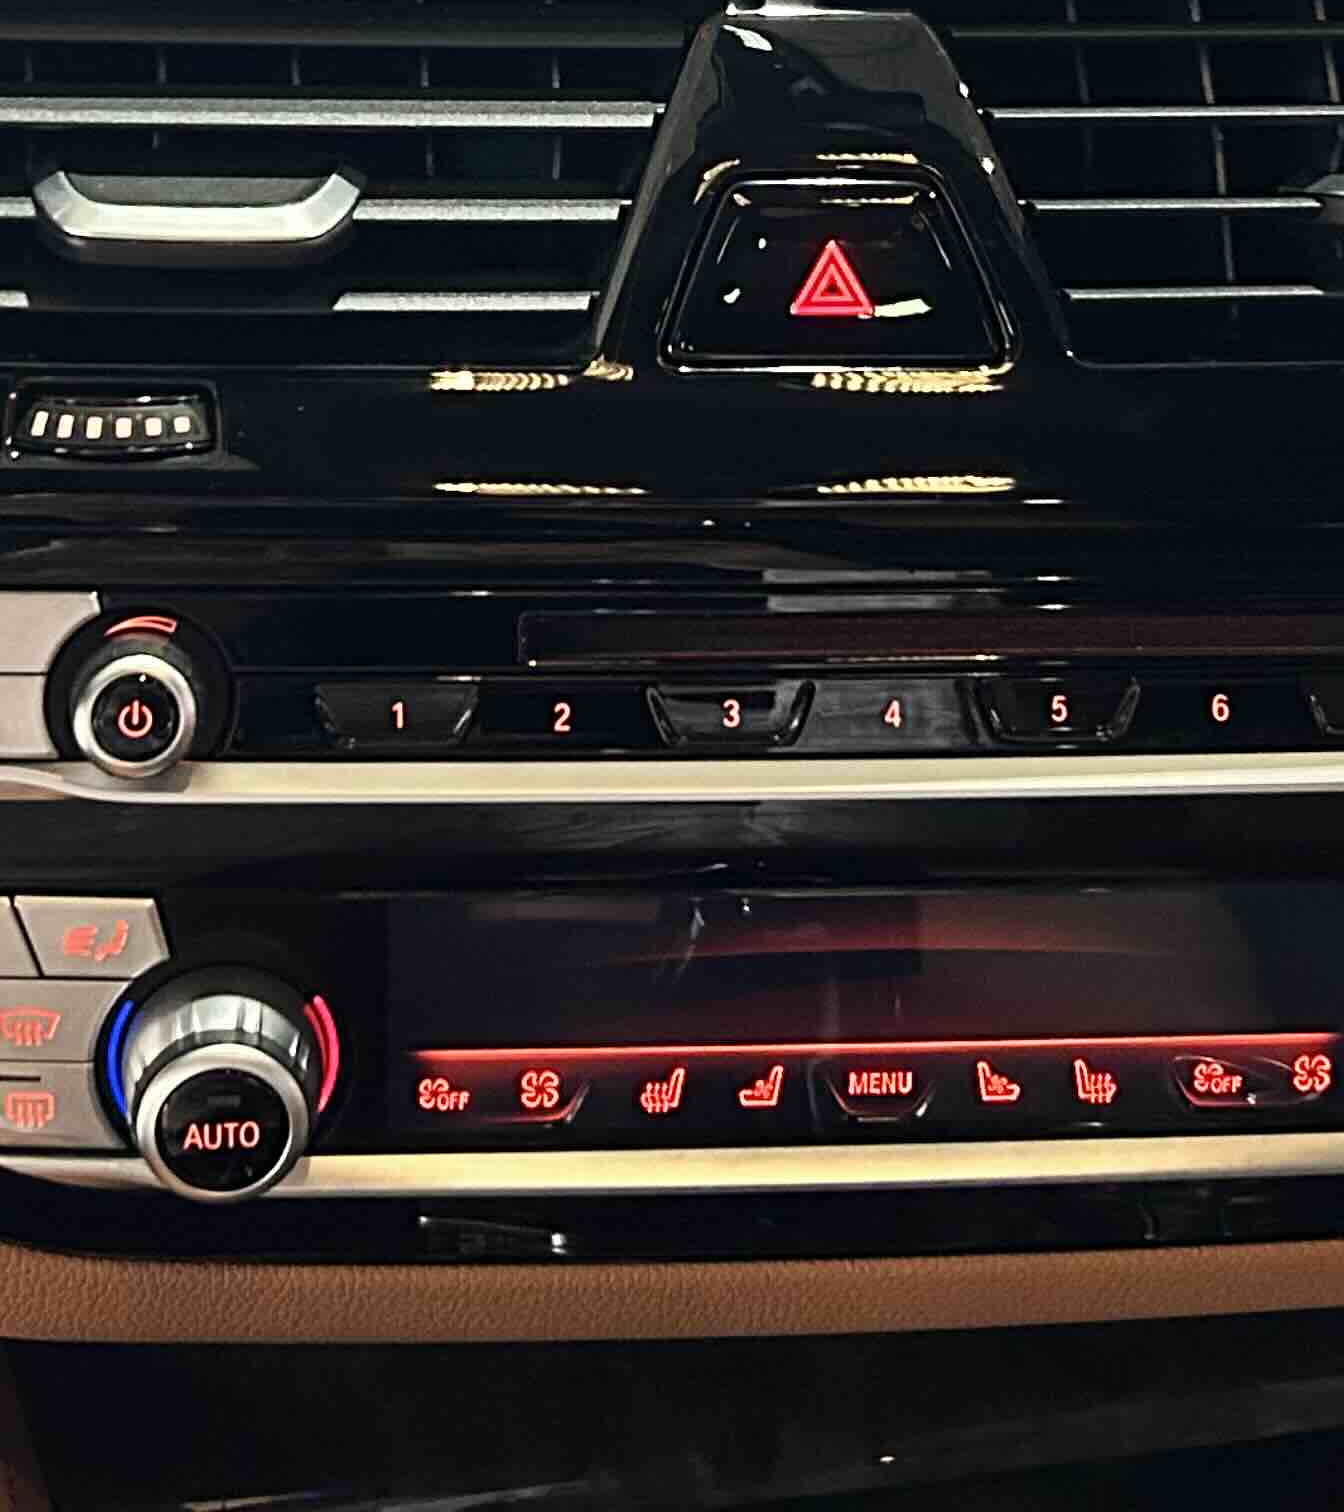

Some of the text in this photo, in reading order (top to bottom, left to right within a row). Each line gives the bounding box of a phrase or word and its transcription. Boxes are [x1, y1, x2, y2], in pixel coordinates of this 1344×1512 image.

[391, 701, 407, 730] 1
[553, 702, 572, 733] 2
[722, 699, 741, 729] 3
[883, 699, 902, 729] 4
[1050, 694, 1068, 723] 5
[1211, 693, 1229, 722] 6
[848, 1070, 913, 1095] MENU
[1211, 1074, 1243, 1094] OFF
[437, 1090, 471, 1112] OFF
[184, 1120, 261, 1151] AUTO
